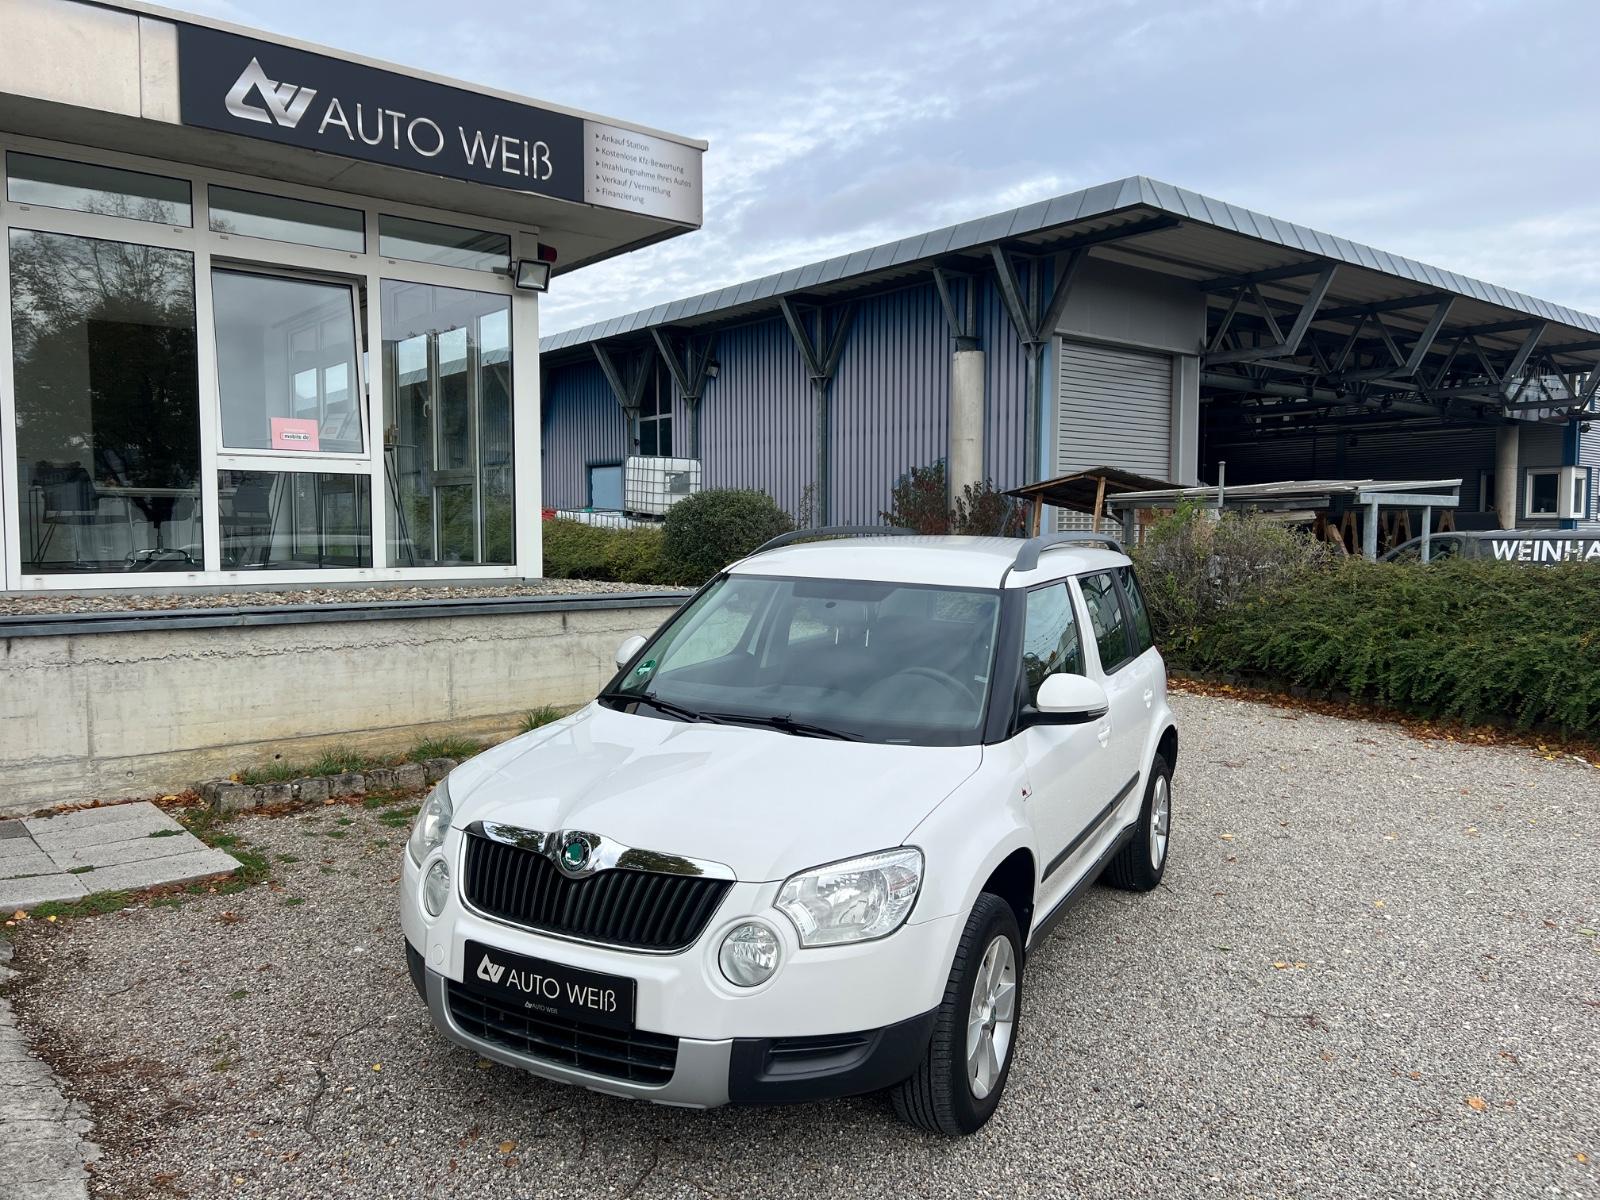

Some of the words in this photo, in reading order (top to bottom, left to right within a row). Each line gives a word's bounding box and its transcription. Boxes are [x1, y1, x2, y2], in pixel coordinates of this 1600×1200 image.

[318, 97, 445, 158] AUTO
[458, 126, 553, 181] WEIß
[602, 134, 625, 146] Ankauf
[627, 141, 650, 152] Station
[602, 147, 637, 162] Kostenlose
[639, 156, 684, 175] Kfz-Bewertung
[602, 161, 656, 178] Inzahlungnahme
[674, 178, 692, 188] Autos
[602, 176, 627, 187] Verkauf
[634, 182, 672, 198] Vermittlung
[602, 187, 645, 205] Finanzierung
[506, 969, 560, 999] AUTO
[566, 982, 617, 1012] WEIß
